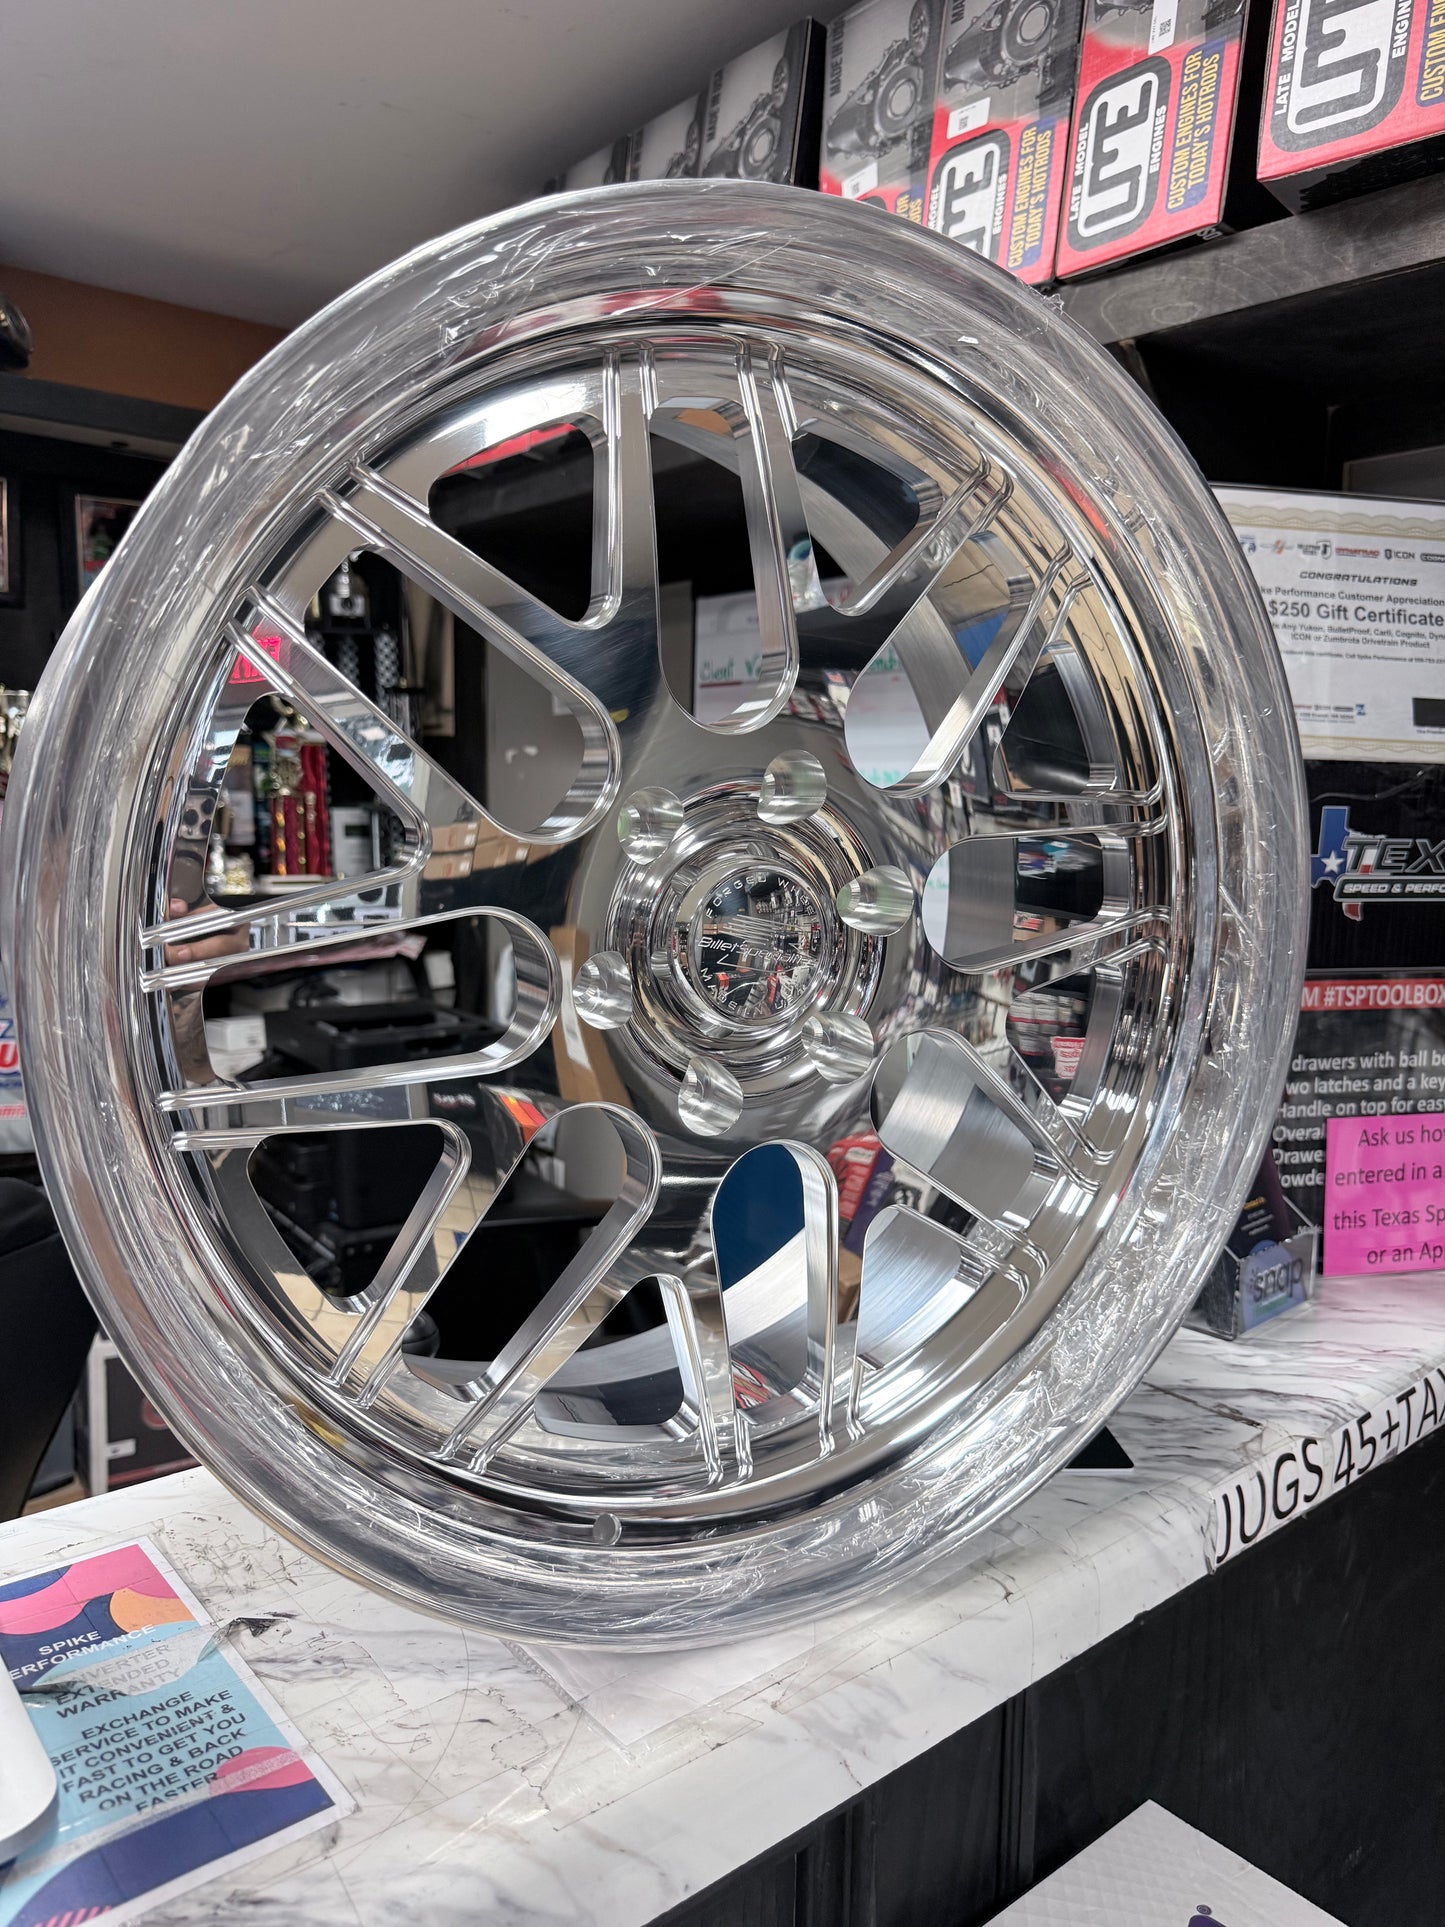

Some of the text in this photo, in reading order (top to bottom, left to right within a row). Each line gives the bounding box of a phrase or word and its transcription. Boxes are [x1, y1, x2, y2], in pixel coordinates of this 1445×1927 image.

[1392, 0, 1412, 58] ENGIN
[830, 59, 843, 97] MADE
[1275, 0, 1300, 115] LATE MODEL
[1420, 28, 1445, 101] CUSTOM
[1150, 105, 1167, 174] ENGINES
[1168, 50, 1202, 209] CUSTOM ENGINES FOR
[1188, 53, 1220, 190] TODAY'S HOTRODS
[1008, 126, 1037, 268] CUSTOM ENGINES FOR
[1025, 130, 1052, 250] TODAY'S HOTRODS
[1069, 122, 1089, 222] LATE MODEL
[993, 173, 1008, 235] ENGINES
[1299, 571, 1418, 587] CONGRATULATIONS
[1394, 551, 1415, 559] ICON
[1269, 600, 1444, 626] $250 Gift Certificate
[1275, 586, 1335, 599] Performance
[1338, 591, 1383, 602] Customer
[1386, 594, 1445, 606] Appreciation
[1343, 883, 1389, 893] SPEED
[1391, 883, 1402, 893] &
[1324, 984, 1445, 1007] #TSPTOOLBOX
[1286, 1073, 1445, 1095] wo latches and a key
[1292, 1054, 1356, 1072] drawers
[1360, 1052, 1394, 1069] with
[1400, 1050, 1427, 1067] ball
[1336, 1102, 1356, 1114] on
[1360, 1100, 1387, 1116] top
[1391, 1096, 1413, 1112] for
[1358, 1127, 1389, 1147] Ask
[1396, 1129, 1415, 1144] us
[1279, 1168, 1325, 1188] owde
[1335, 1163, 1442, 1186] entered in a
[1333, 1210, 1367, 1230] this
[1372, 1208, 1420, 1226] Texas
[1367, 1242, 1445, 1265] or an Ap
[1216, 1367, 1445, 1564] JUGS 45+TA
[9, 1624, 156, 1680] ERFORMANCE
[39, 1631, 101, 1656] SPIKE
[51, 1690, 233, 1767] SERVICE TO MAKE
[81, 1690, 194, 1740] EXCHANGE
[59, 1704, 236, 1779] IT CONVENIENT &
[62, 1713, 246, 1794] FAST TO GET YOU
[79, 1728, 246, 1803] RACING & BACK
[98, 1745, 244, 1812] ON THE ROAD
[135, 1772, 218, 1814] FASTER
